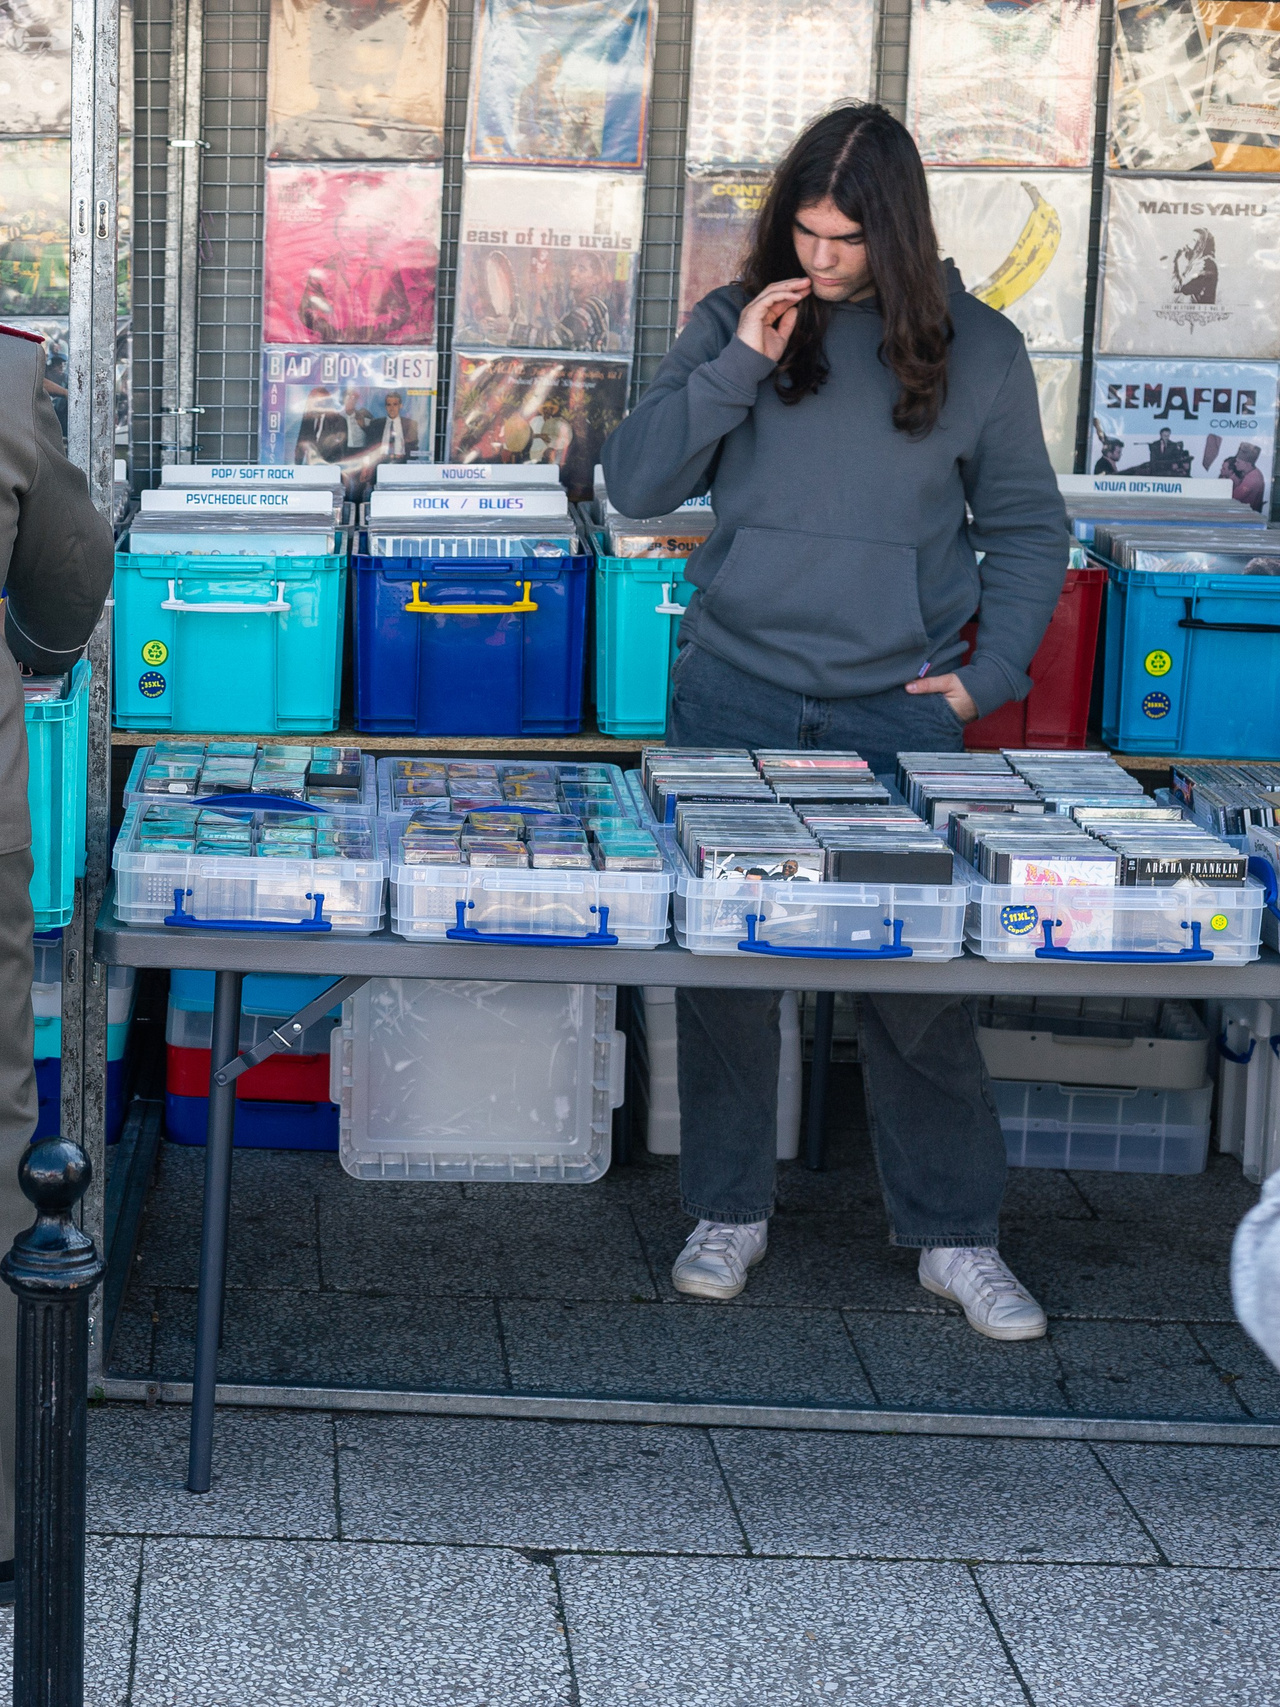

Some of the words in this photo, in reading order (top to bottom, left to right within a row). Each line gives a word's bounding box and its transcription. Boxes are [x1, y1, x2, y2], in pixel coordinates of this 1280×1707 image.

[1138, 201, 1268, 216] MATISYAHU
[467, 229, 508, 244] east
[516, 227, 534, 245] of
[541, 228, 571, 246] the
[579, 231, 632, 250] urals
[268, 353, 311, 382] BAD
[322, 353, 372, 383] BOYS
[384, 355, 434, 380] BEST
[1107, 383, 1257, 420] SEMAFOR
[1210, 419, 1258, 429] COMBO
[211, 468, 236, 479] POP/
[239, 468, 265, 479] SOFT
[267, 469, 294, 479] ROCK
[1094, 481, 1126, 491] NOWA
[1129, 481, 1182, 493] DOSTAWA
[186, 494, 257, 505] PSYCHEDELIC
[260, 495, 289, 505] ROCK
[413, 498, 450, 509] ROCK
[479, 498, 524, 509] BLUES
[1145, 862, 1183, 874] ARETHA
[1190, 862, 1239, 874] FRANKLIN
[1007, 922, 1035, 935] Capacity
